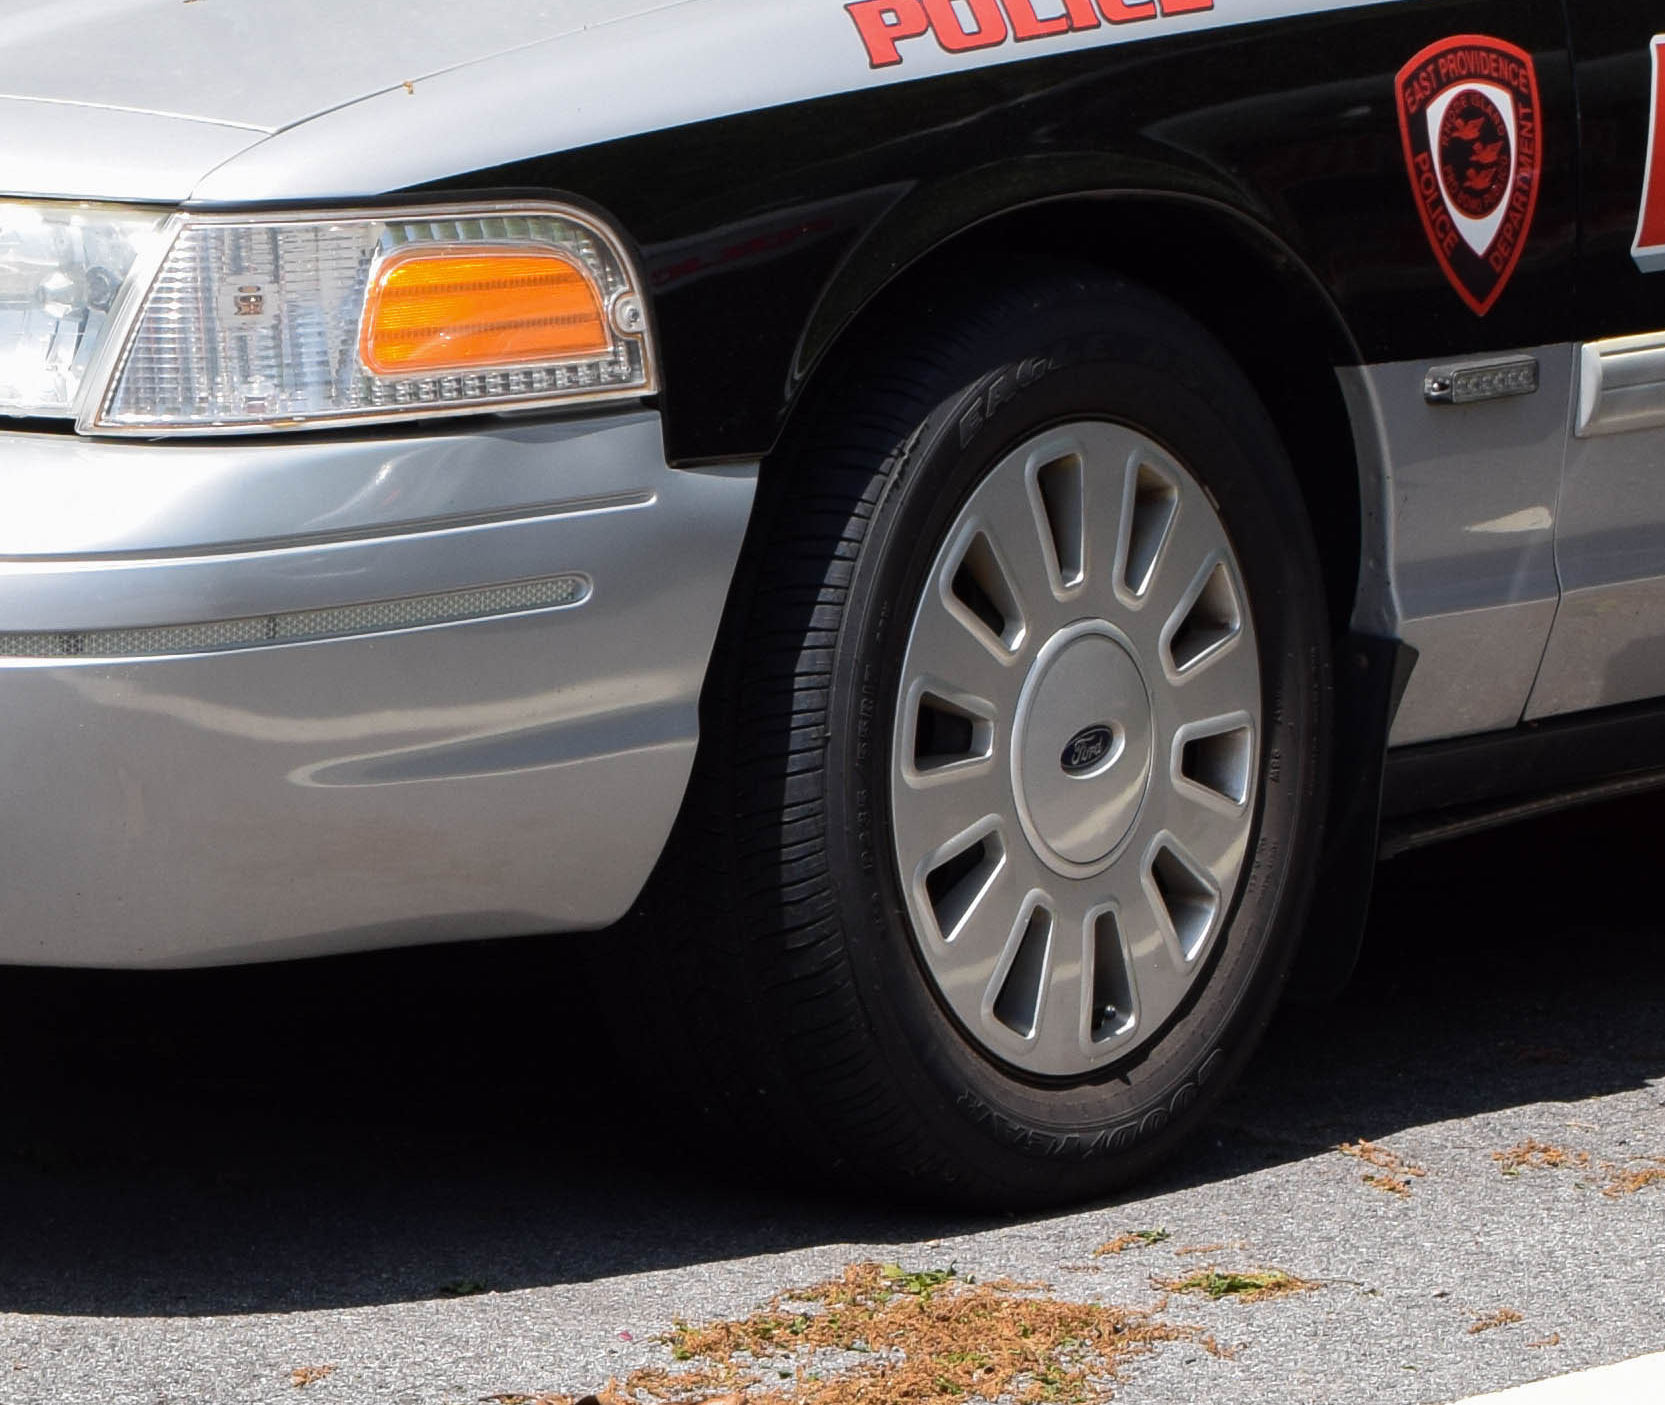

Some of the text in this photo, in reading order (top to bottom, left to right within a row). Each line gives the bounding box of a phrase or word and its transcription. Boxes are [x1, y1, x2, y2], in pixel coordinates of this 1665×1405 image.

[1405, 48, 1528, 114] EAST PROVIDENCE
[1414, 151, 1459, 256] POLICE
[1488, 104, 1535, 273] DEPARTMENT
[1072, 734, 1104, 765] Ford
